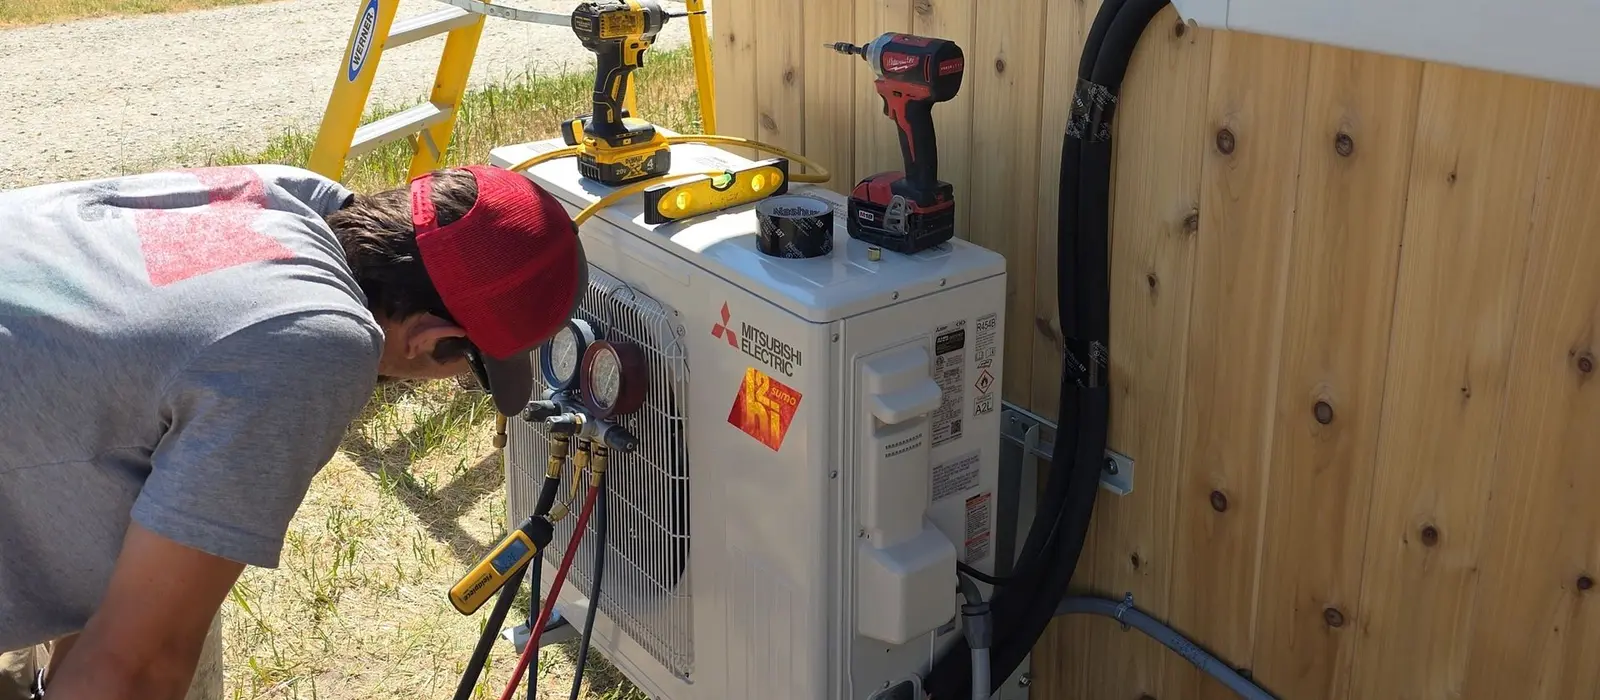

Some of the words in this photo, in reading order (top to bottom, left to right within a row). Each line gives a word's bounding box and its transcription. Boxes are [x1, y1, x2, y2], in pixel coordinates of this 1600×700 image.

[353, 12, 374, 66] WERNER
[646, 159, 654, 168] 4
[976, 318, 996, 332] R454B
[741, 322, 802, 366] MITSUBISHI
[741, 338, 794, 377] ELECTRIC
[770, 386, 797, 406] sumo
[975, 401, 993, 415] A2L
[462, 573, 493, 601] Fieldpiece
